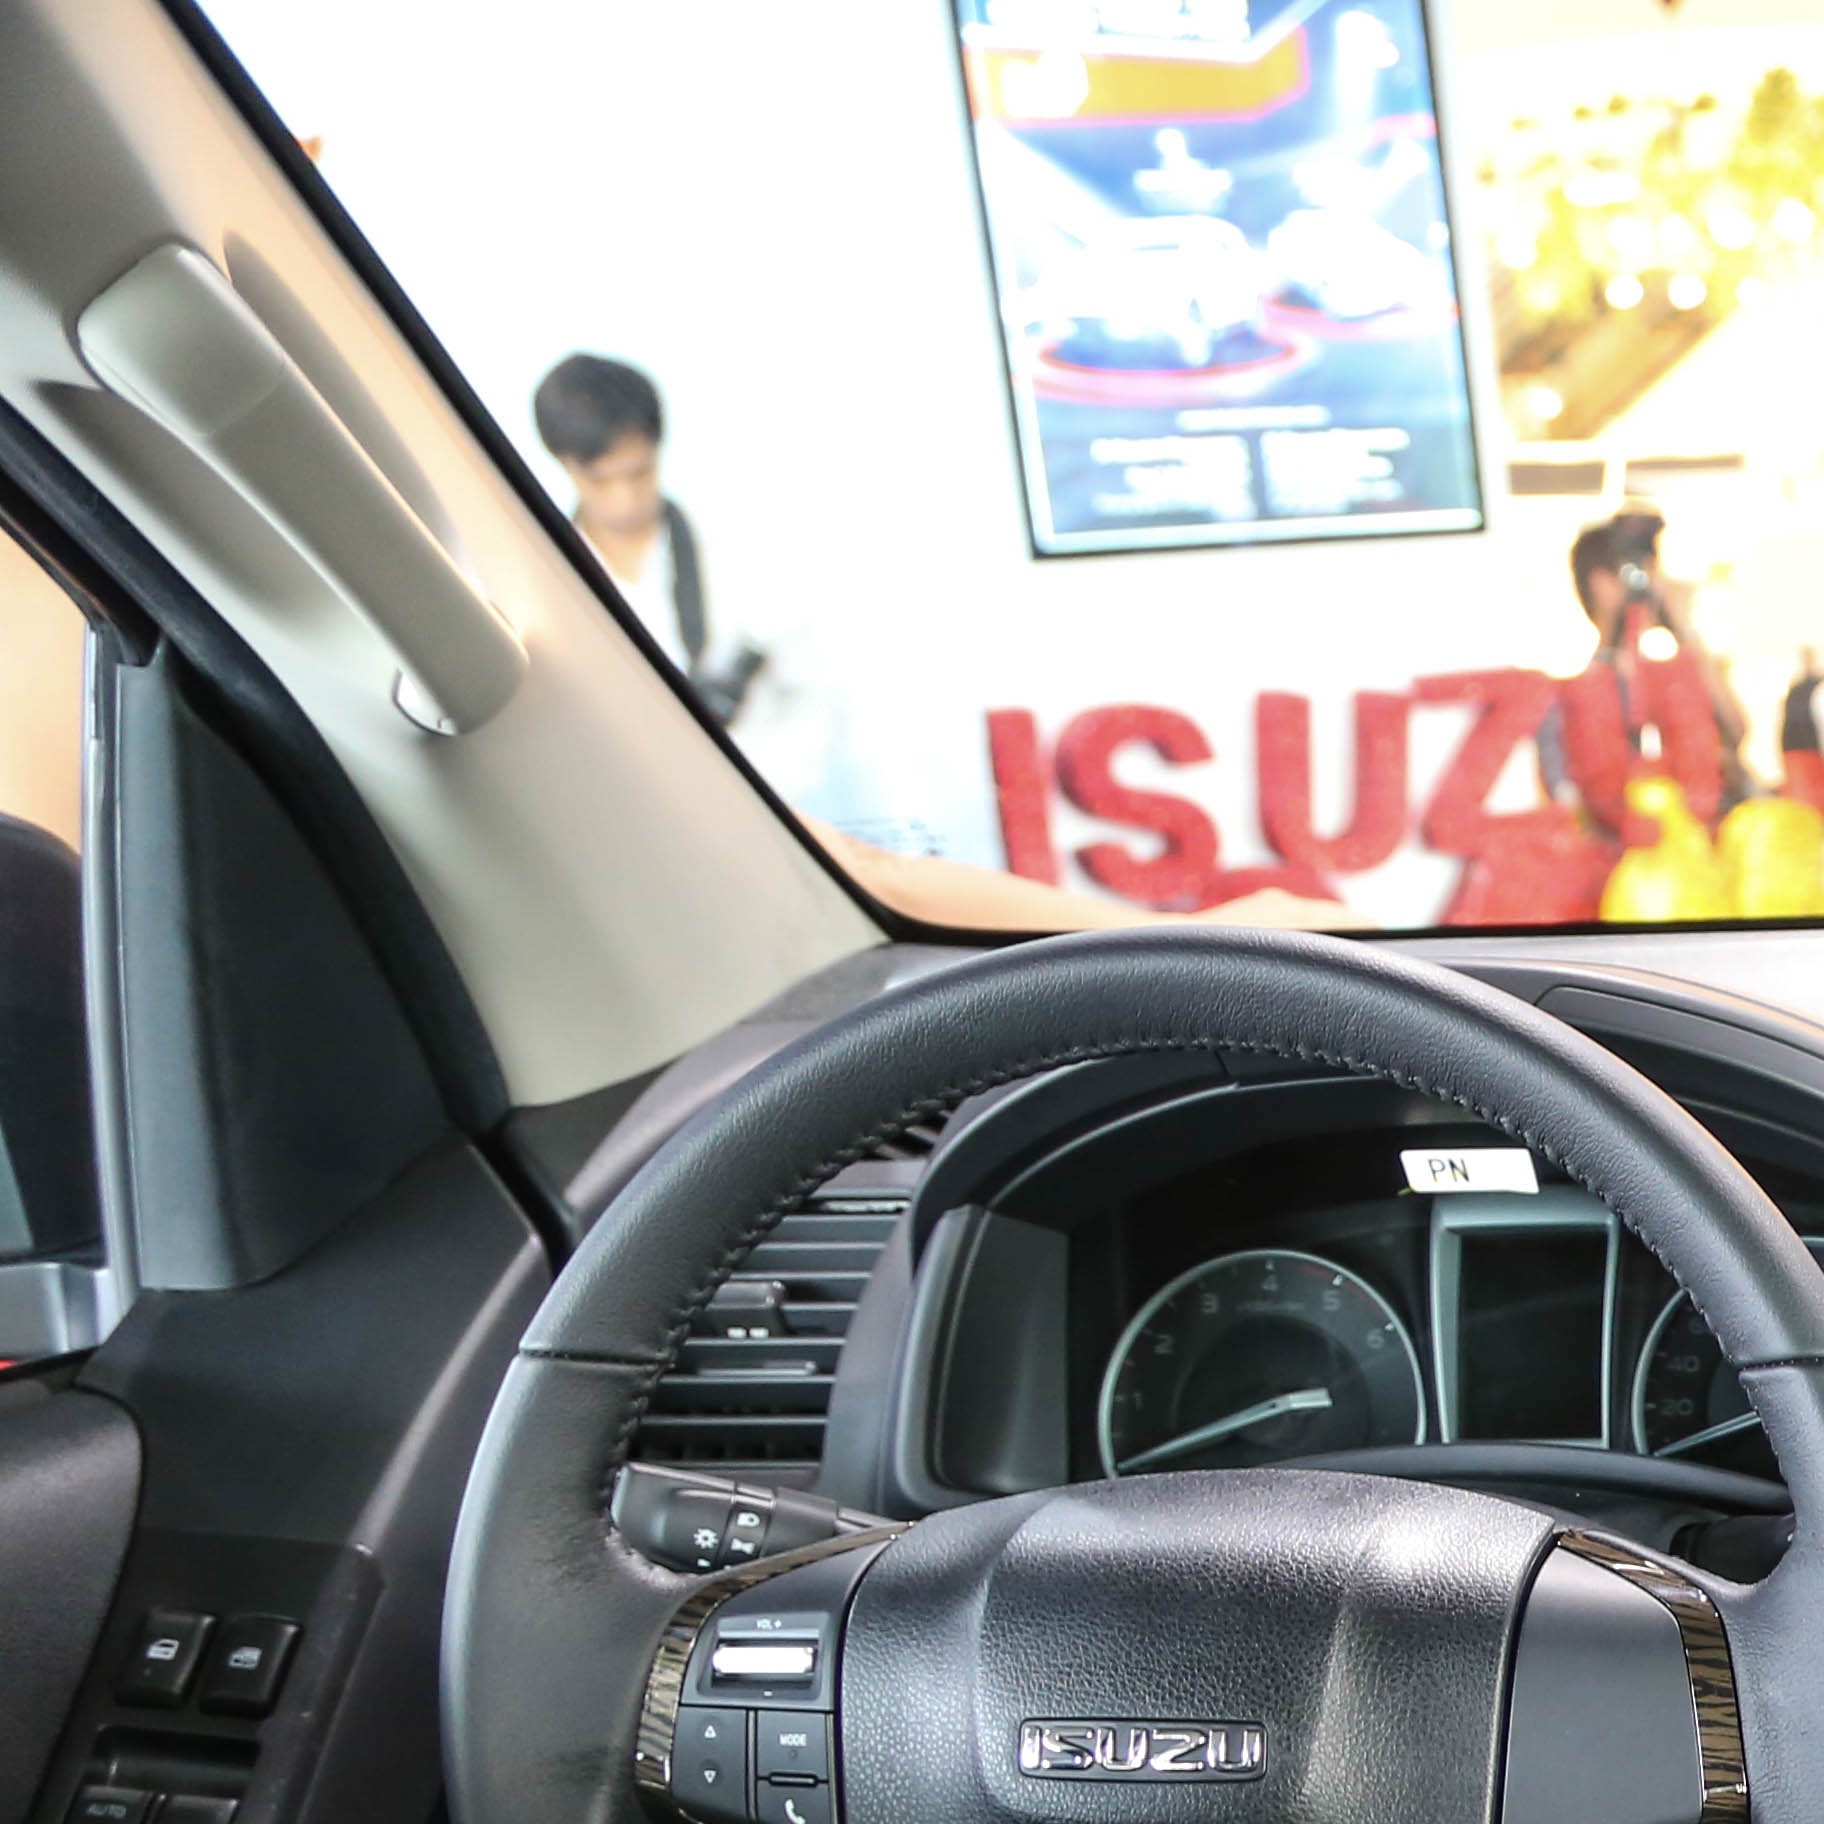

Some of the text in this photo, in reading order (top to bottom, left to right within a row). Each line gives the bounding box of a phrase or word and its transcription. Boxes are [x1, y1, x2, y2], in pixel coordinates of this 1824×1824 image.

[1428, 1158, 1470, 1183] PN
[1200, 1294, 1220, 1314] 3
[1322, 1290, 1341, 1311] 5
[1020, 1726, 1262, 1773] ISUZU
